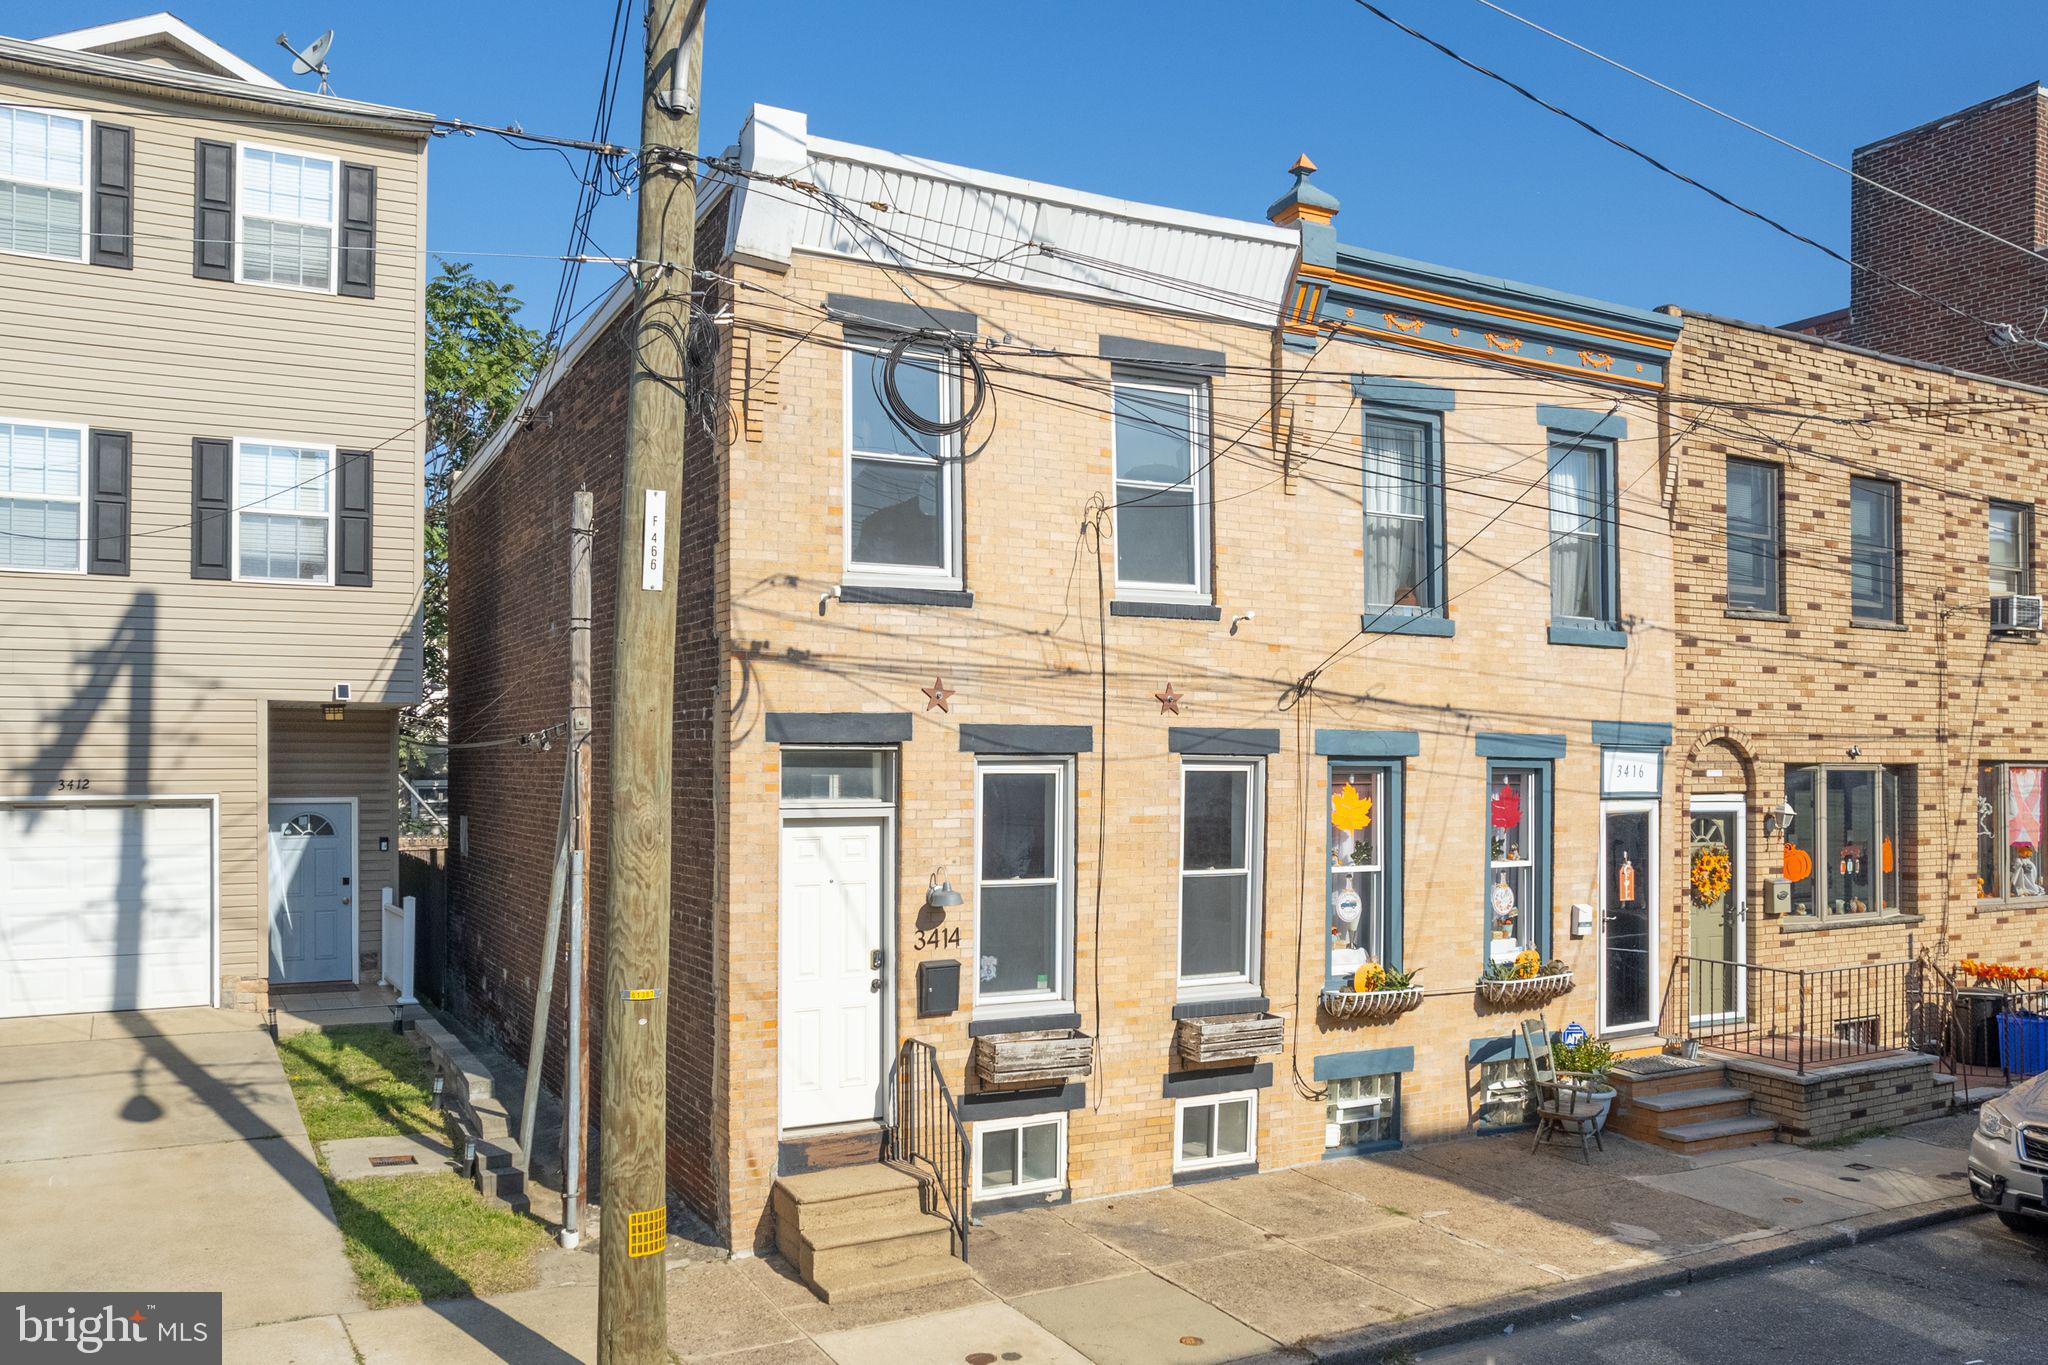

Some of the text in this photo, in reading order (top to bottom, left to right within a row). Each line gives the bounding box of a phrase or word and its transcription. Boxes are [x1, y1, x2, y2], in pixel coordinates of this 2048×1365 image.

[650, 515, 658, 571] F 466
[1616, 764, 1645, 778] 3416
[57, 779, 90, 791] 3412
[914, 926, 962, 951] 3414
